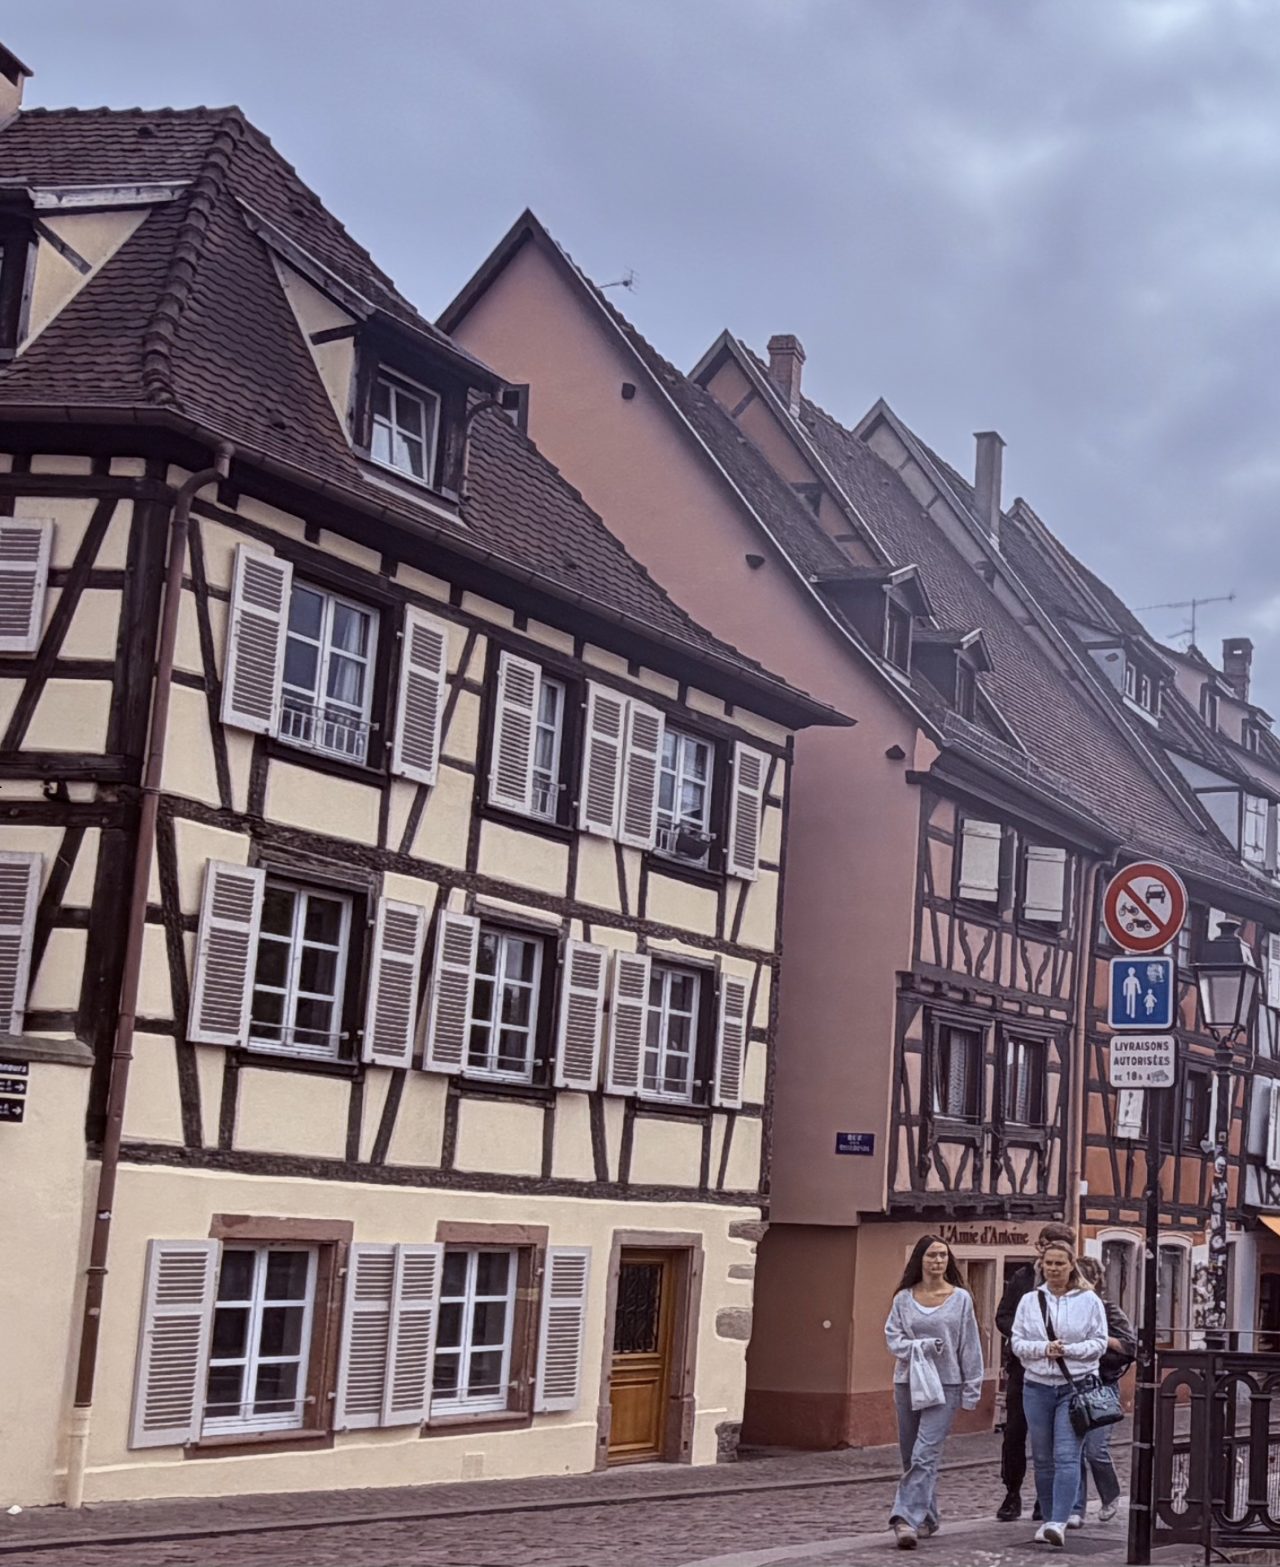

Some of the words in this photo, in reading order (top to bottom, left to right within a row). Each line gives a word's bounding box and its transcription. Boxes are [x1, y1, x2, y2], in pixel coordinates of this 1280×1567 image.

[1114, 1041, 1169, 1051] LIVRAISONS
[1113, 1055, 1171, 1066] AUTORISÉES
[980, 1226, 1029, 1245] d'Antoine
